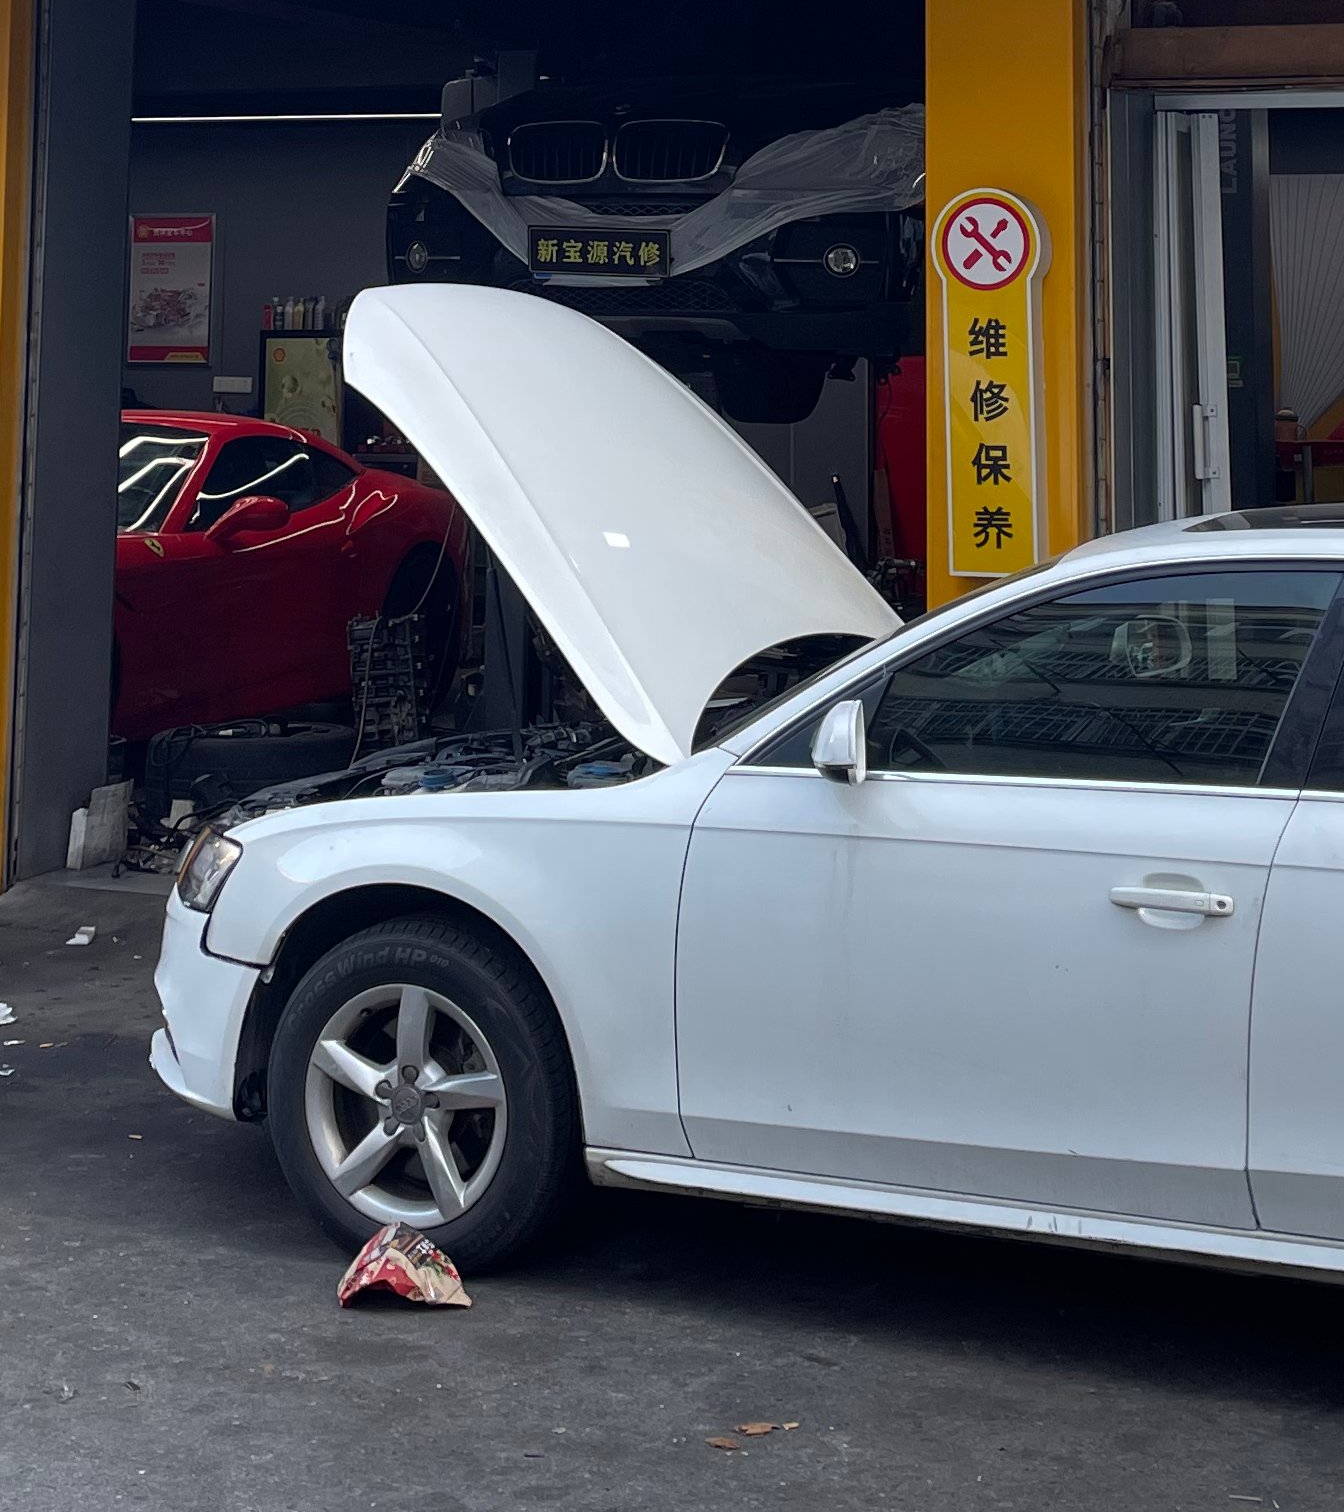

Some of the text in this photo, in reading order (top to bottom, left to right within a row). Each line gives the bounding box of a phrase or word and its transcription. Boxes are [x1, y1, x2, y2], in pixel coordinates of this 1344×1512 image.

[537, 239, 660, 266] 新宝源汽修
[968, 317, 1014, 549] 维修保养
